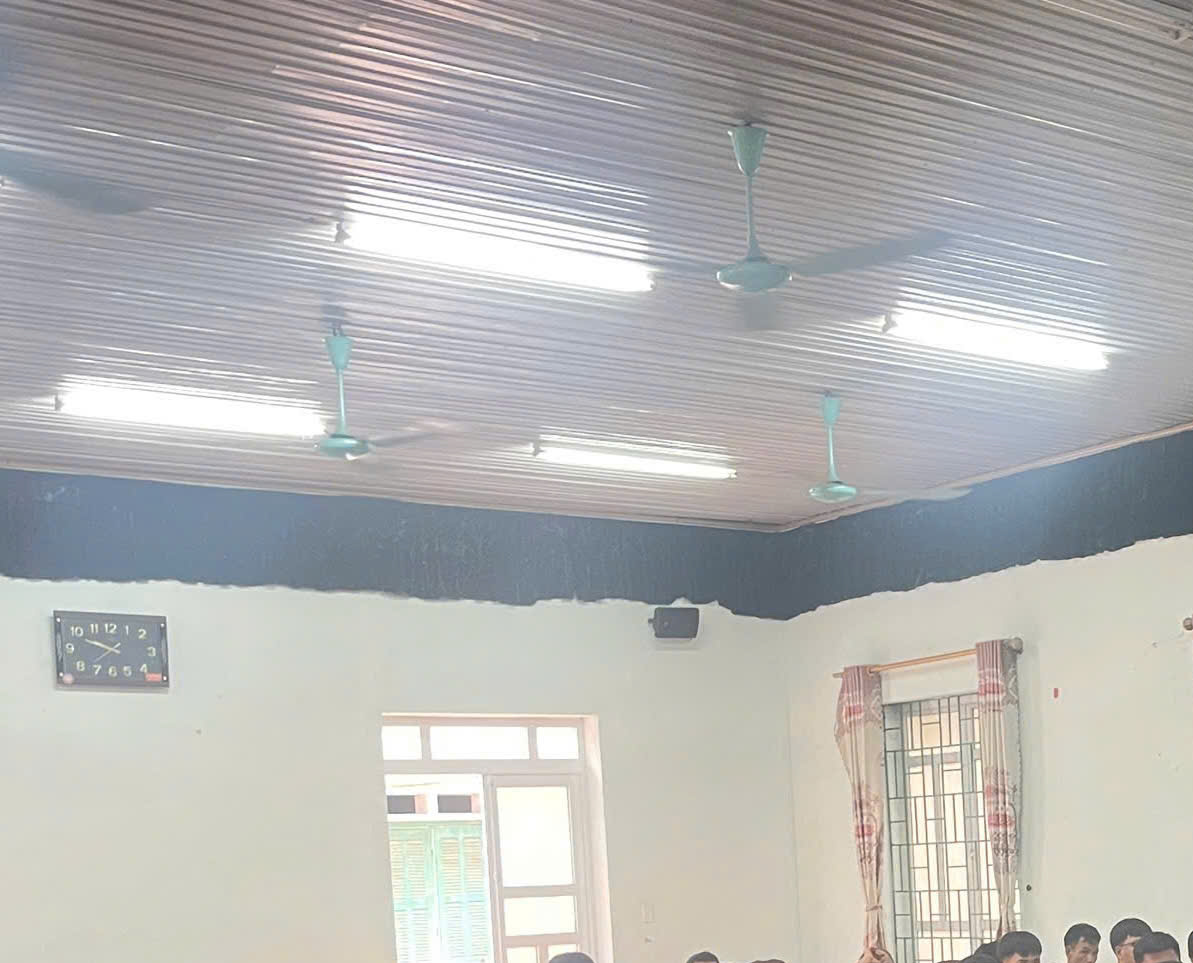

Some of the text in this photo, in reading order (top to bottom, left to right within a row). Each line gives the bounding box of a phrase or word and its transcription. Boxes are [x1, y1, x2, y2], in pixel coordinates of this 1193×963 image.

[70, 625, 84, 637] 10
[90, 623, 99, 634] 11
[104, 623, 117, 634] 12
[125, 625, 129, 636] 1
[138, 628, 147, 640] 2
[65, 642, 75, 654] 9
[147, 646, 156, 657] 3
[76, 660, 85, 672] 8
[92, 664, 102, 676] 7
[108, 666, 118, 677] 6
[123, 666, 132, 677] 5
[139, 663, 148, 673] 4
